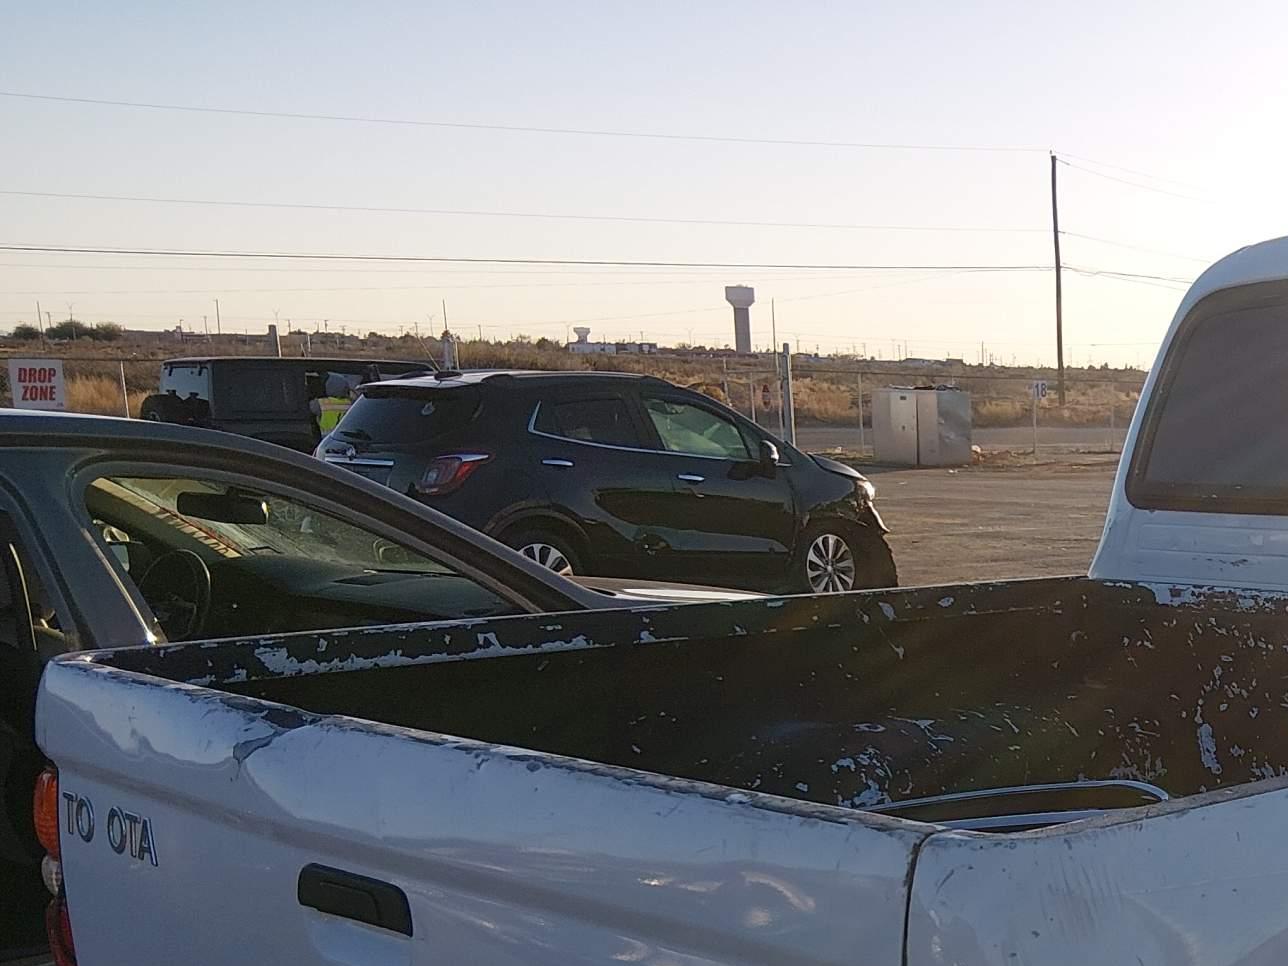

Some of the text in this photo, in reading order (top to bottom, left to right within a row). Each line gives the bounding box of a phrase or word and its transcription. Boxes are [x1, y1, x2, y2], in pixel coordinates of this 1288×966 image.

[17, 367, 57, 383] DROP
[21, 385, 56, 401] ZONE
[1034, 383, 1047, 398] 18
